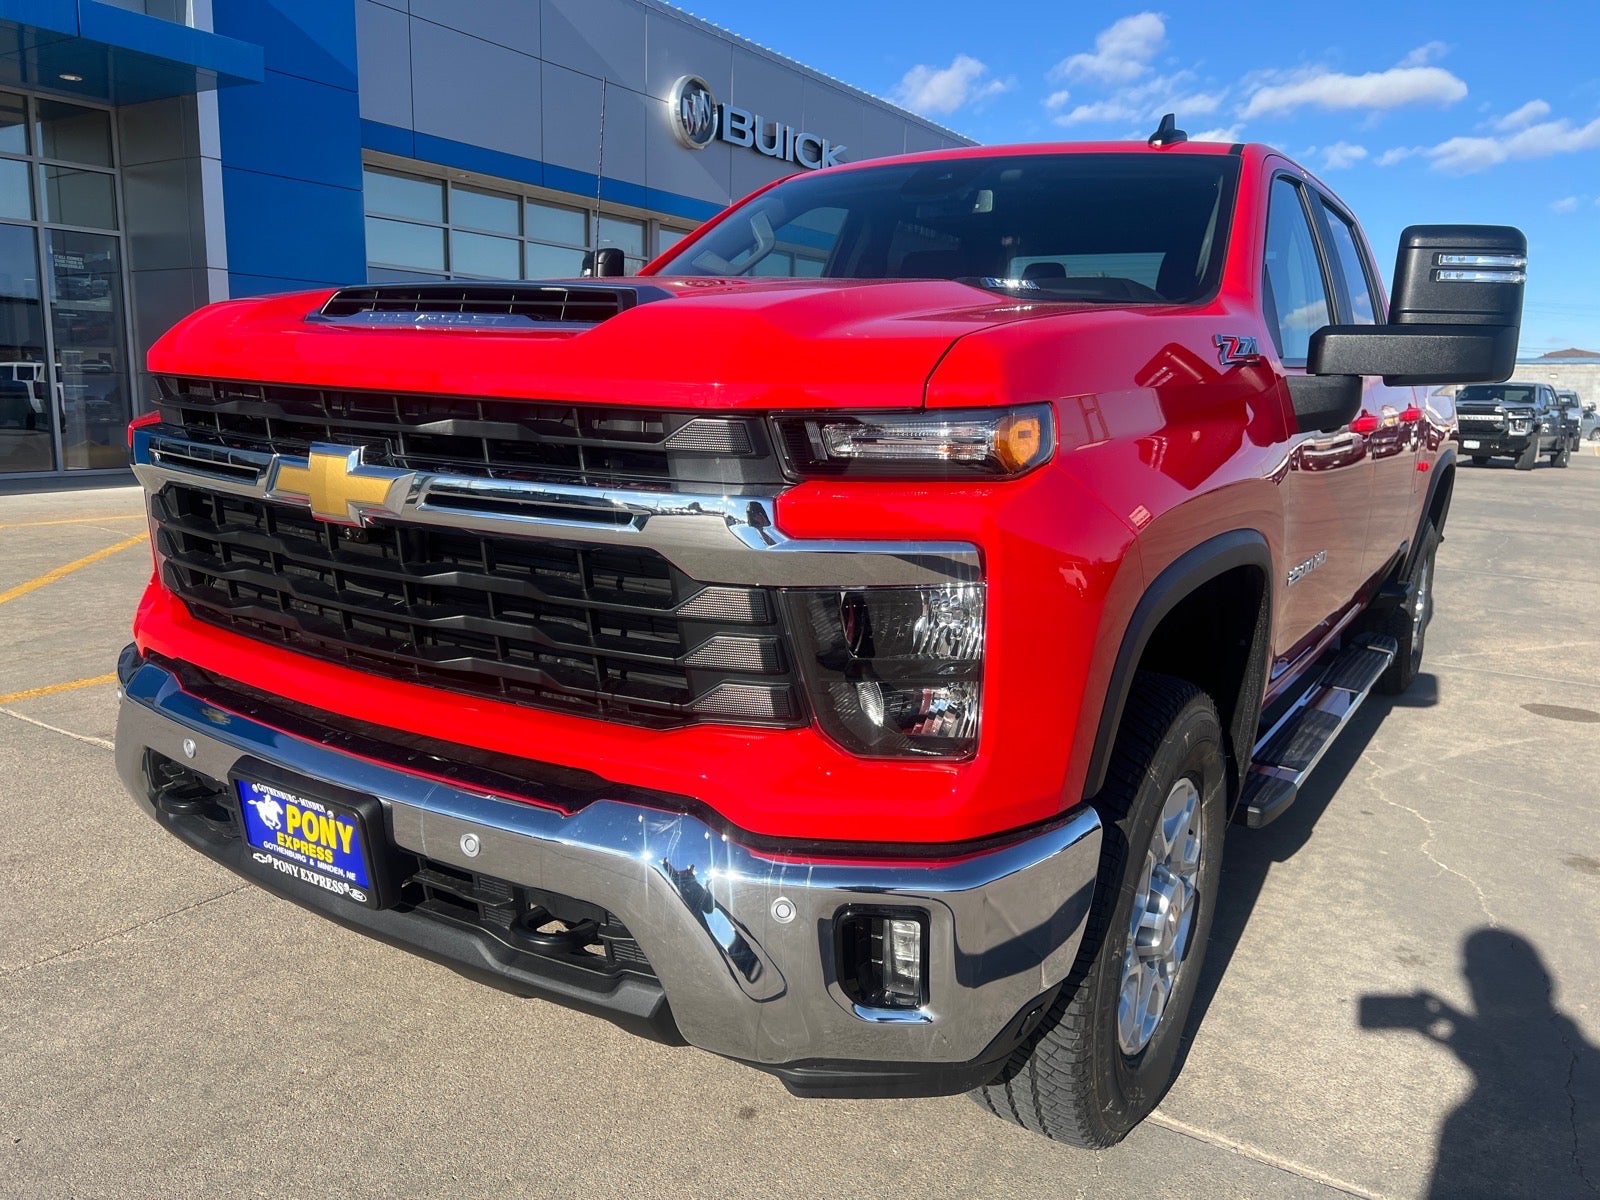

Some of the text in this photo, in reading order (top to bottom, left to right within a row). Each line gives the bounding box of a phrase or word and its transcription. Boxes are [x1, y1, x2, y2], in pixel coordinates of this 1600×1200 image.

[722, 103, 847, 170] BUICK
[1215, 334, 1258, 365] Z71
[277, 831, 334, 864] EXPRESS
[286, 803, 353, 854] PONY
[263, 840, 307, 863] GOTHENBURG
[309, 858, 315, 866] &
[346, 870, 356, 881] NE
[272, 857, 344, 895] PONY EXPRESS
